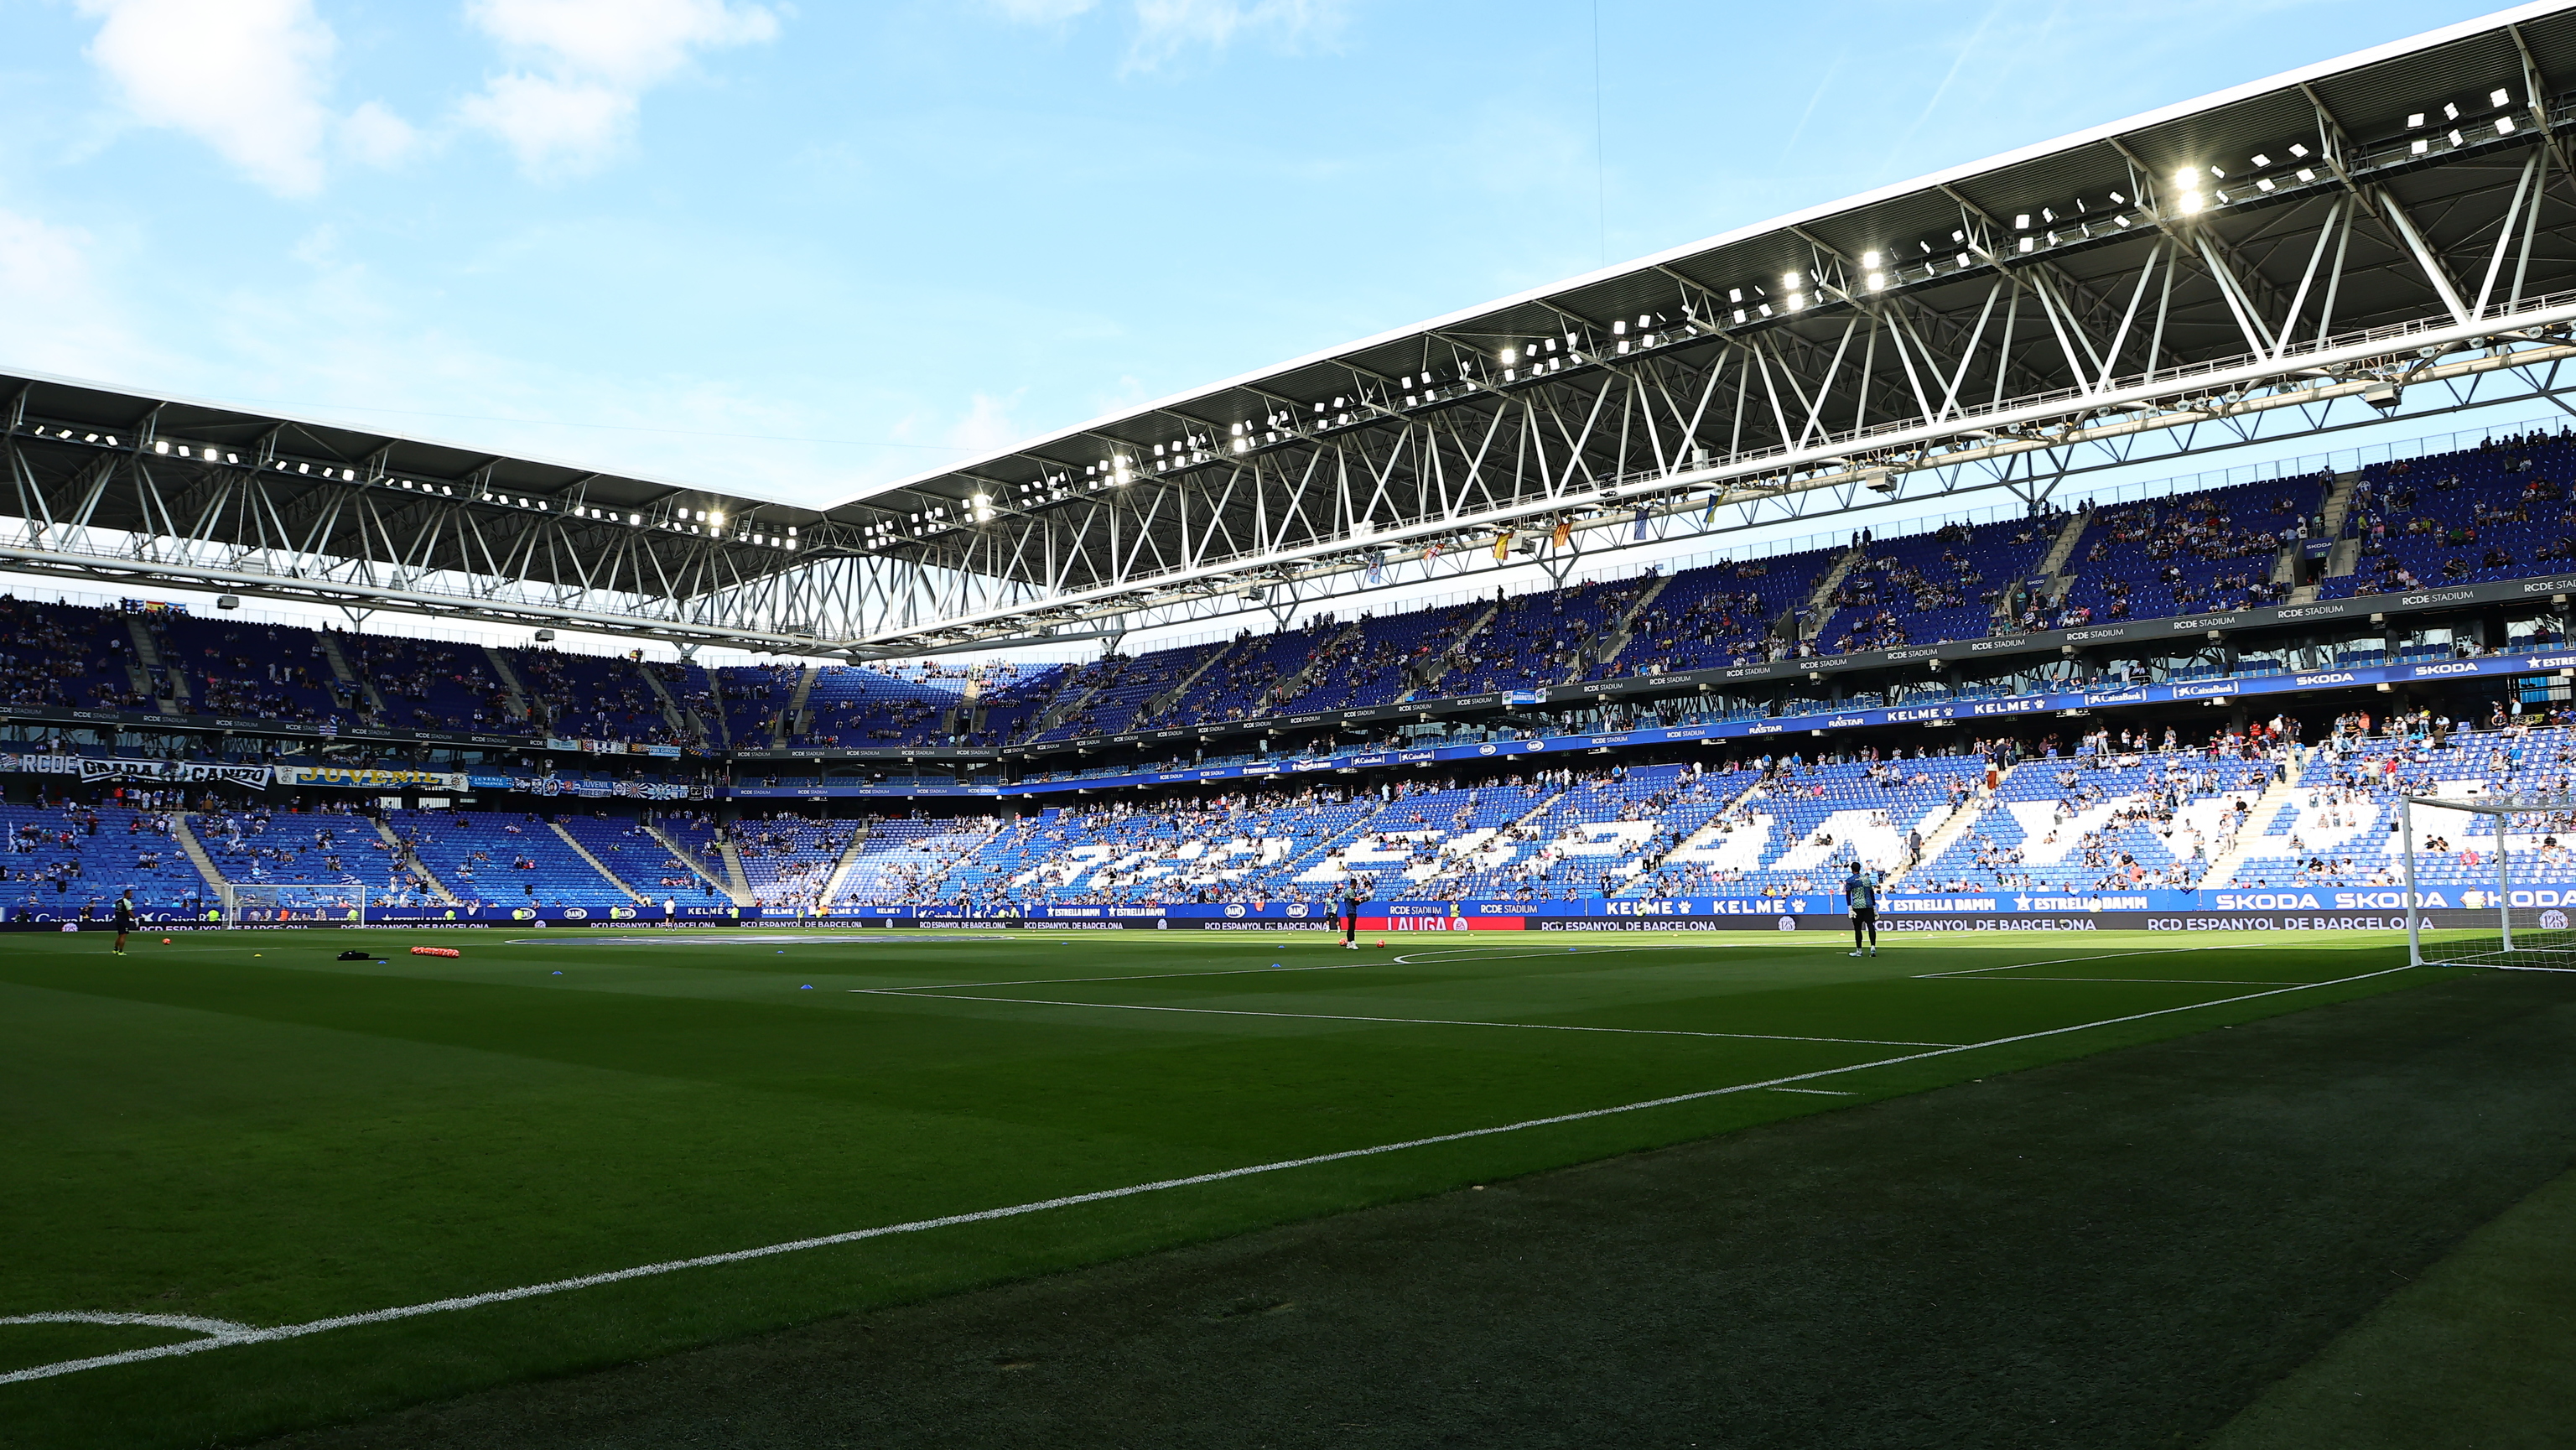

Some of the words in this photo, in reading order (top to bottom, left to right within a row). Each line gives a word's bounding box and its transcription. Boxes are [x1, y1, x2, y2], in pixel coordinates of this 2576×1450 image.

[2524, 583, 2554, 592] RCDE
[2402, 596, 2430, 605] RCDE
[2432, 592, 2474, 602] STADIUM
[2277, 610, 2303, 618] RCDE
[2305, 605, 2344, 616] STADIUM
[2199, 617, 2236, 627] STADIUM
[2090, 629, 2123, 638] STADIUM
[1972, 642, 1993, 651] RCDE
[1994, 639, 2025, 647] STADIUM
[1908, 649, 1938, 657] STADIUM
[2416, 663, 2478, 675] SKODA
[2297, 673, 2354, 684] SKODA
[2190, 684, 2232, 694] CaixaBank
[2101, 693, 2141, 702] CaixaBank
[1975, 699, 2030, 714] KELME
[1888, 709, 1939, 722] KELME
[1829, 718, 1863, 727] RASTAR
[1749, 725, 1782, 734] RASTAR
[1408, 753, 1432, 761] CaixaBank
[22, 755, 76, 774] RCDE
[84, 761, 153, 777] GRADA
[192, 767, 265, 782] CANITO
[300, 767, 443, 783] JUVENIL
[1893, 899, 1953, 911] ESTRELLA
[1955, 899, 1996, 911] DAMM
[2103, 896, 2148, 909] DAMM
[2216, 894, 2321, 909] SKODA
[2335, 891, 2448, 909] SKODA
[1390, 906, 1410, 914] RCDE
[1411, 906, 1441, 914] STADIUM
[1481, 905, 1502, 913] RCDE
[1504, 905, 1538, 913] STADIUM
[1607, 901, 1673, 915] KELME
[1713, 900, 1786, 913] KELME
[1542, 922, 1563, 931] RCD
[1566, 922, 1623, 931] ESPANYOL
[1626, 922, 1642, 931] DE
[1644, 921, 1716, 931] BARCELONA
[1873, 920, 1893, 931] CD
[1898, 920, 1972, 931] ESPANYOL
[1976, 920, 1996, 931] DE
[2000, 919, 2096, 931] BARCELONA
[2148, 918, 2182, 930] RCD
[2187, 917, 2281, 930] ESPANYOL
[2284, 917, 2309, 930] DE
[2314, 917, 2434, 929] BARCELOA
